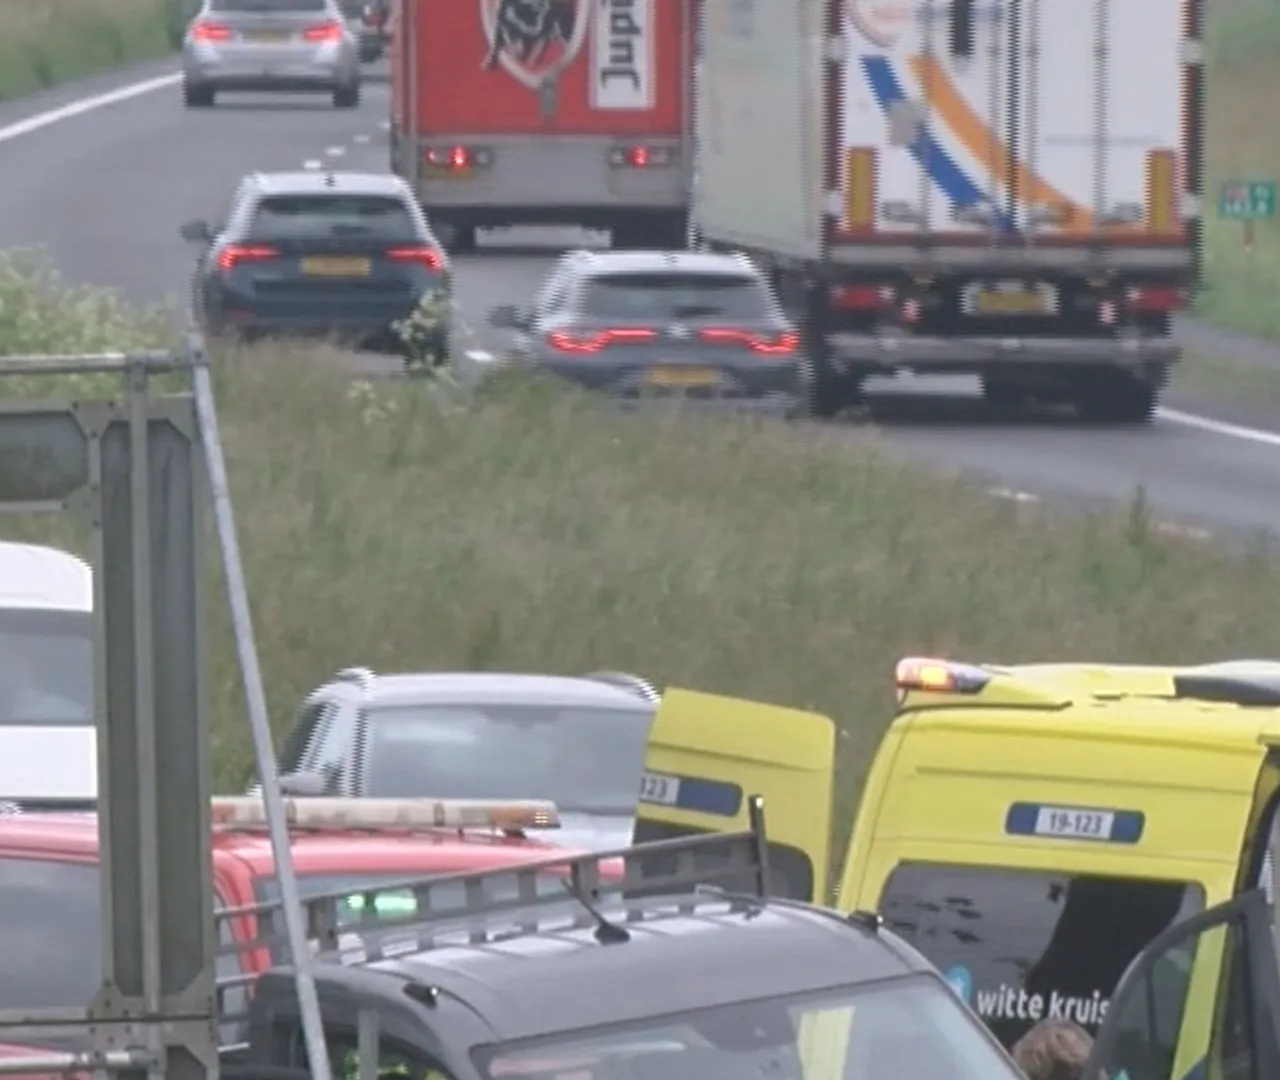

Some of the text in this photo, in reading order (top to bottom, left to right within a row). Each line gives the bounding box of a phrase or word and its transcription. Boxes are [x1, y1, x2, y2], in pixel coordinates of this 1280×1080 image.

[1049, 811, 1104, 835] 19-123
[976, 983, 1111, 1025] witte kruis
